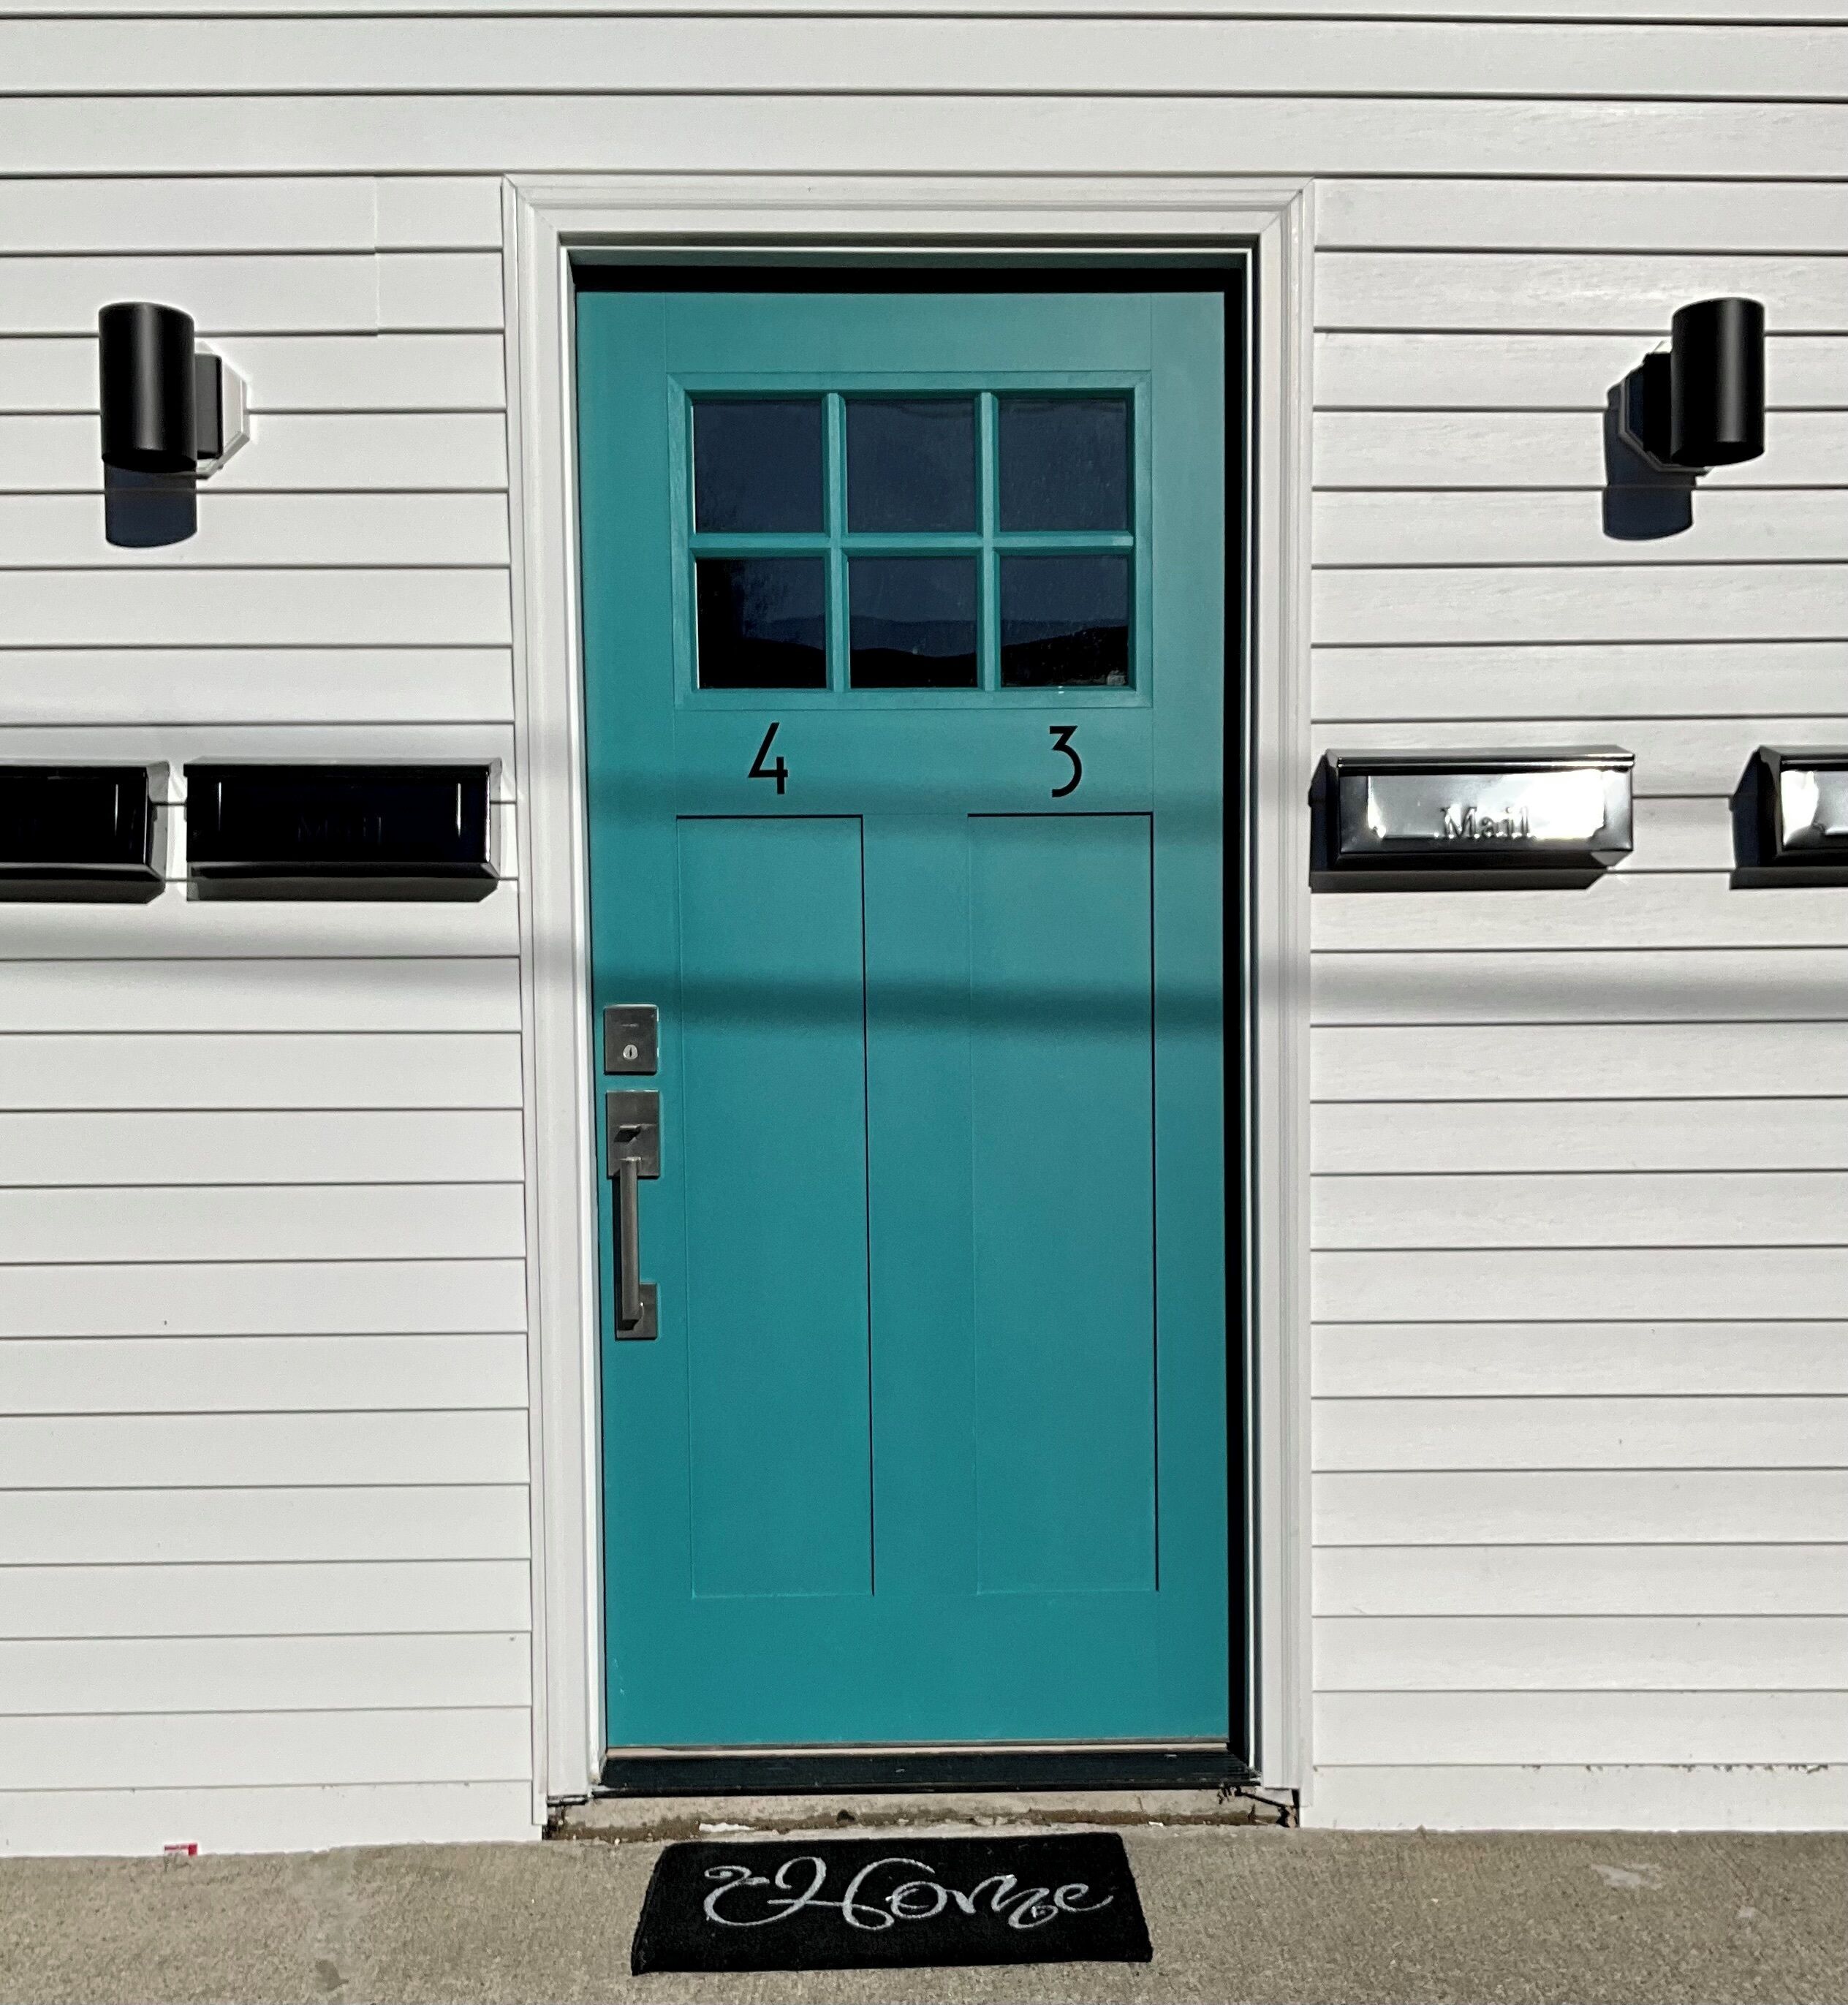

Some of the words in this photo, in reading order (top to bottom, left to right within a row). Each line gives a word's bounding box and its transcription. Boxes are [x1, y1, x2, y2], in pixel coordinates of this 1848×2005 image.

[747, 722, 788, 795] 4
[1049, 725, 1083, 797] 3
[295, 812, 383, 844] Mil
[1440, 806, 1532, 838] Mail
[704, 1855, 1113, 1930] Home
